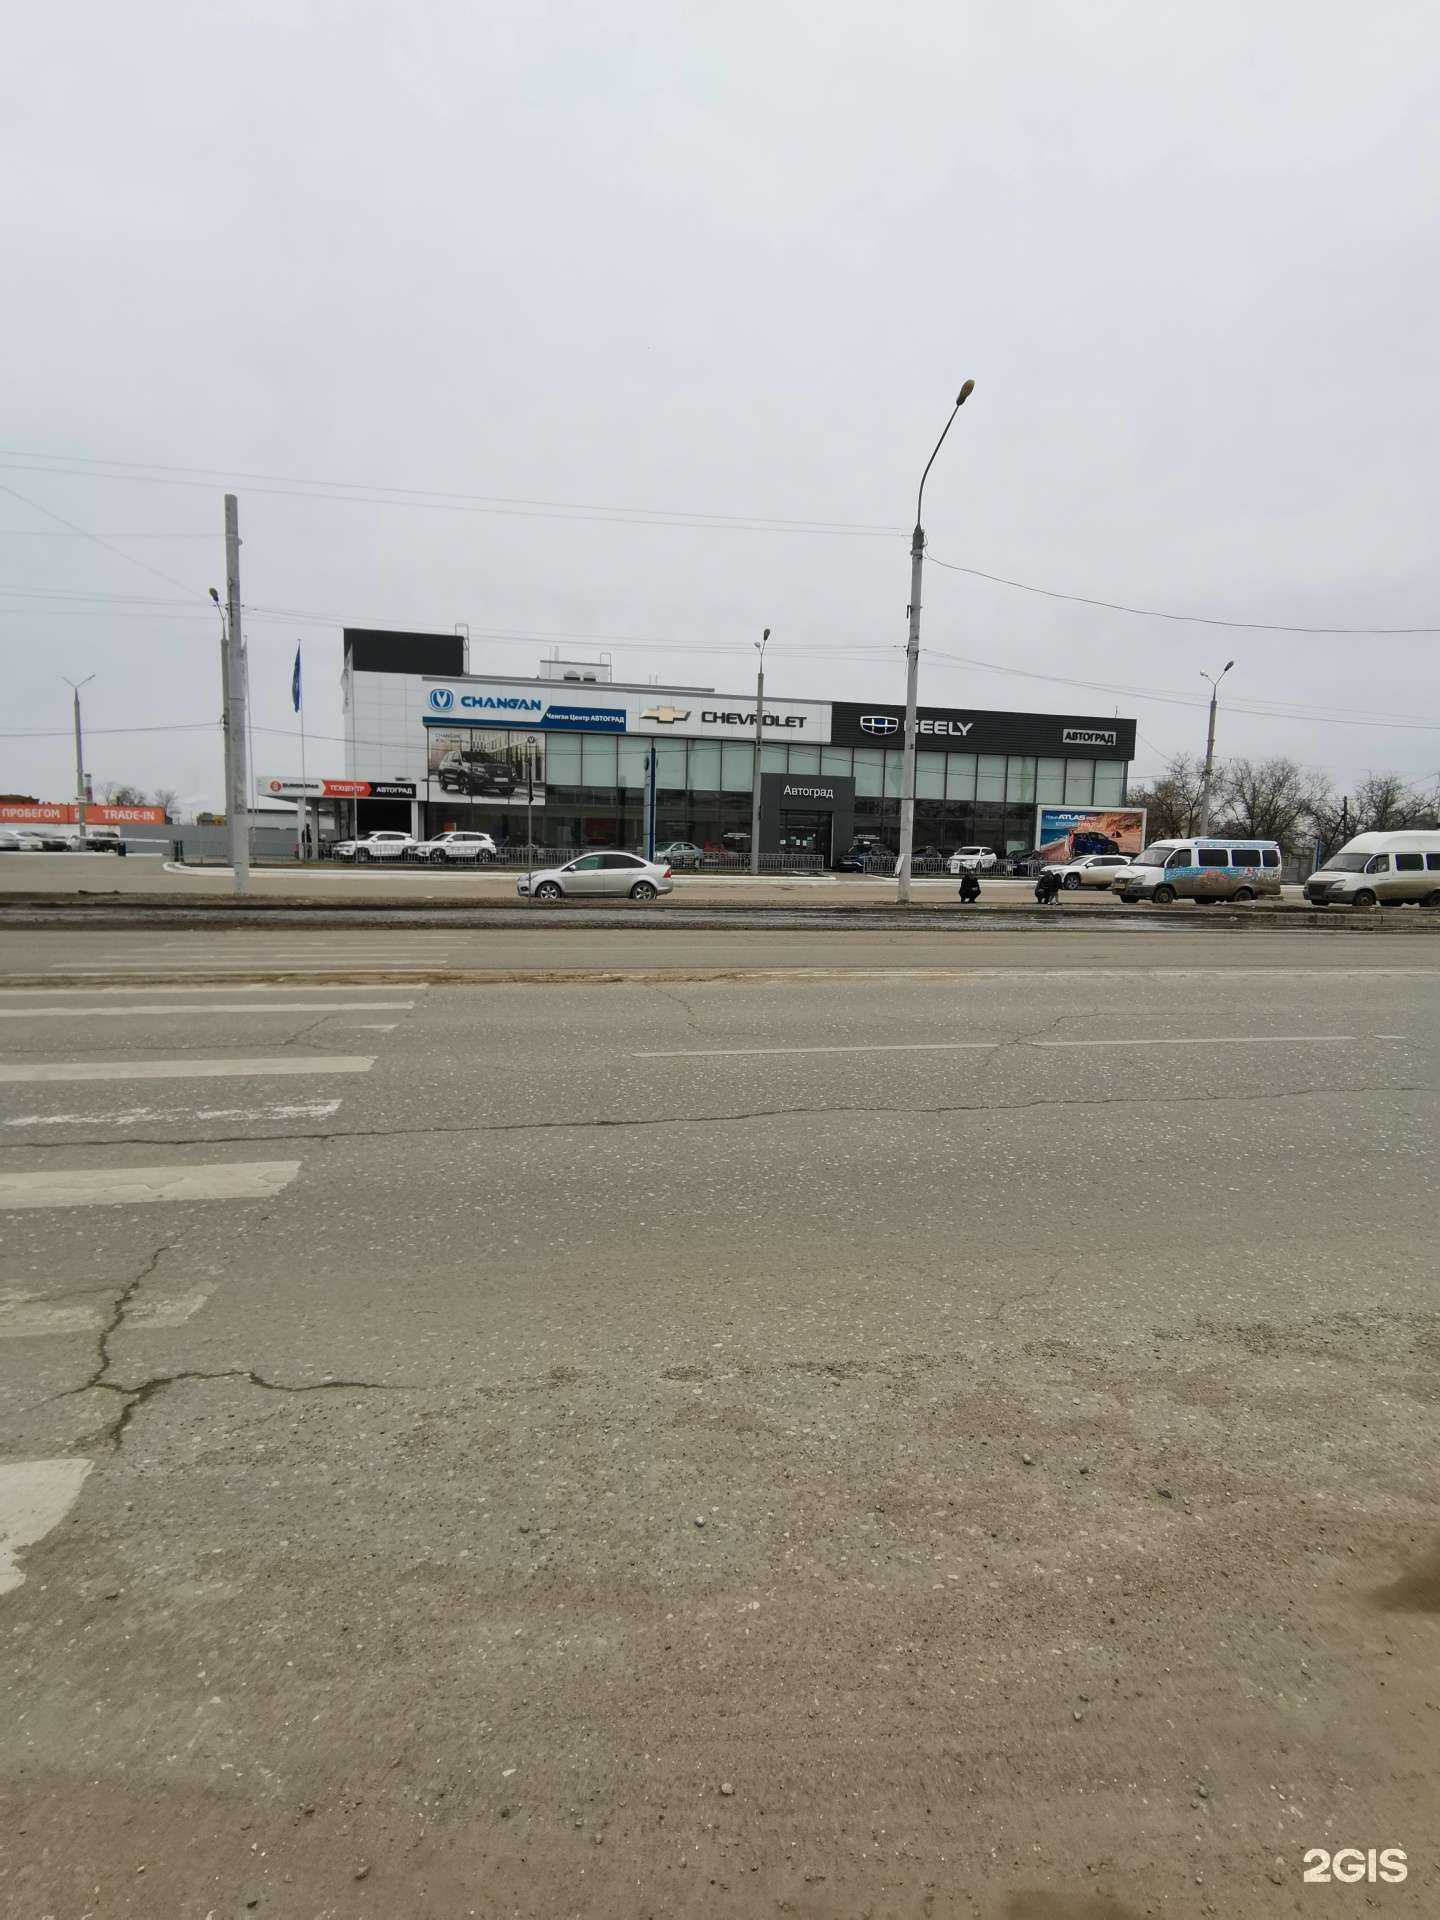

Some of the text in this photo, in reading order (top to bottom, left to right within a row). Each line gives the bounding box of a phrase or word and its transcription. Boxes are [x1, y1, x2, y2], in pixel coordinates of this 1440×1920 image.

[461, 696, 542, 711] CHANGAN
[591, 715, 625, 724] АВТОГРАД
[701, 711, 807, 728] CHEVROLET
[1064, 731, 1115, 745] АВТОГРАД
[376, 786, 413, 795] АВТОГРАД
[784, 785, 834, 798] Автоград
[1, 807, 61, 819] ПРОБЕГОМ
[102, 809, 155, 820] TRADE-IN
